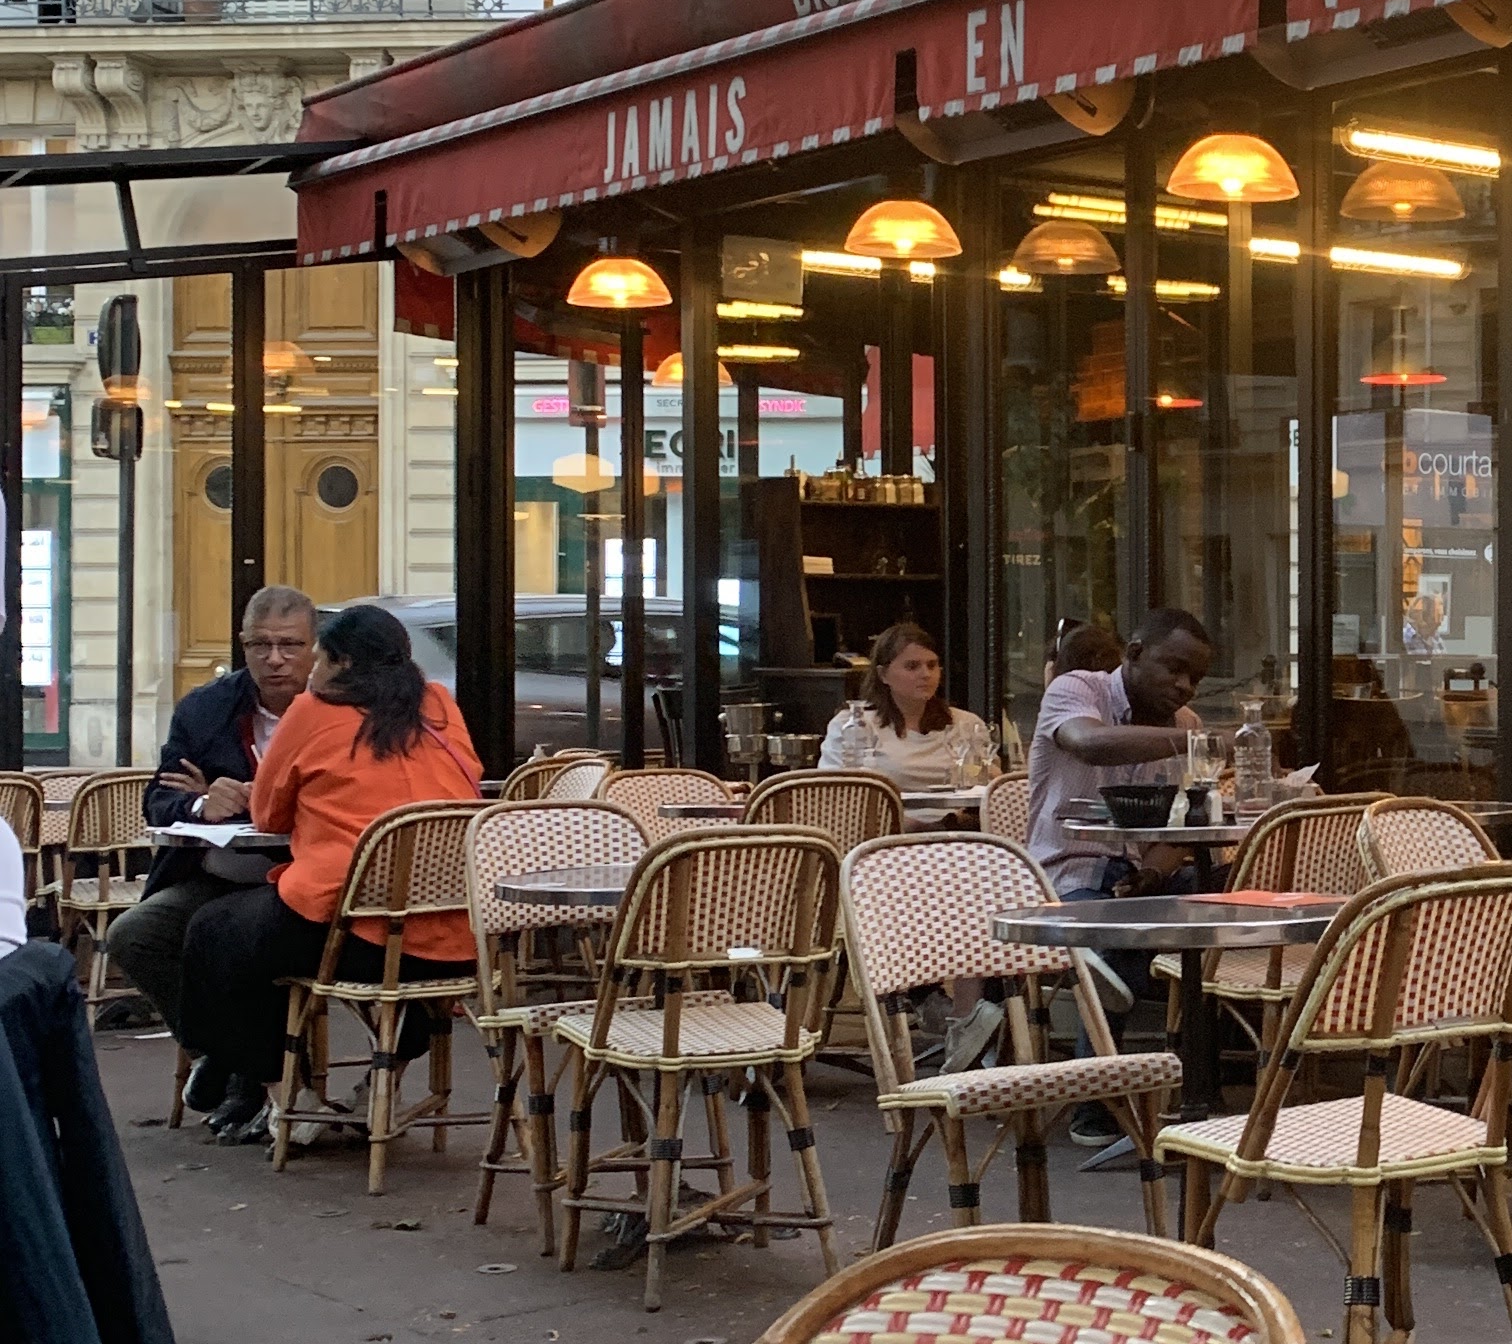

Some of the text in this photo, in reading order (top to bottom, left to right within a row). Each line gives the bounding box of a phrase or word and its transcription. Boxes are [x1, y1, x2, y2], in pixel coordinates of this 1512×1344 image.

[604, 76, 746, 184] JAMAIS
[967, 0, 1025, 94] EN
[1002, 554, 1042, 565] TIREZ
